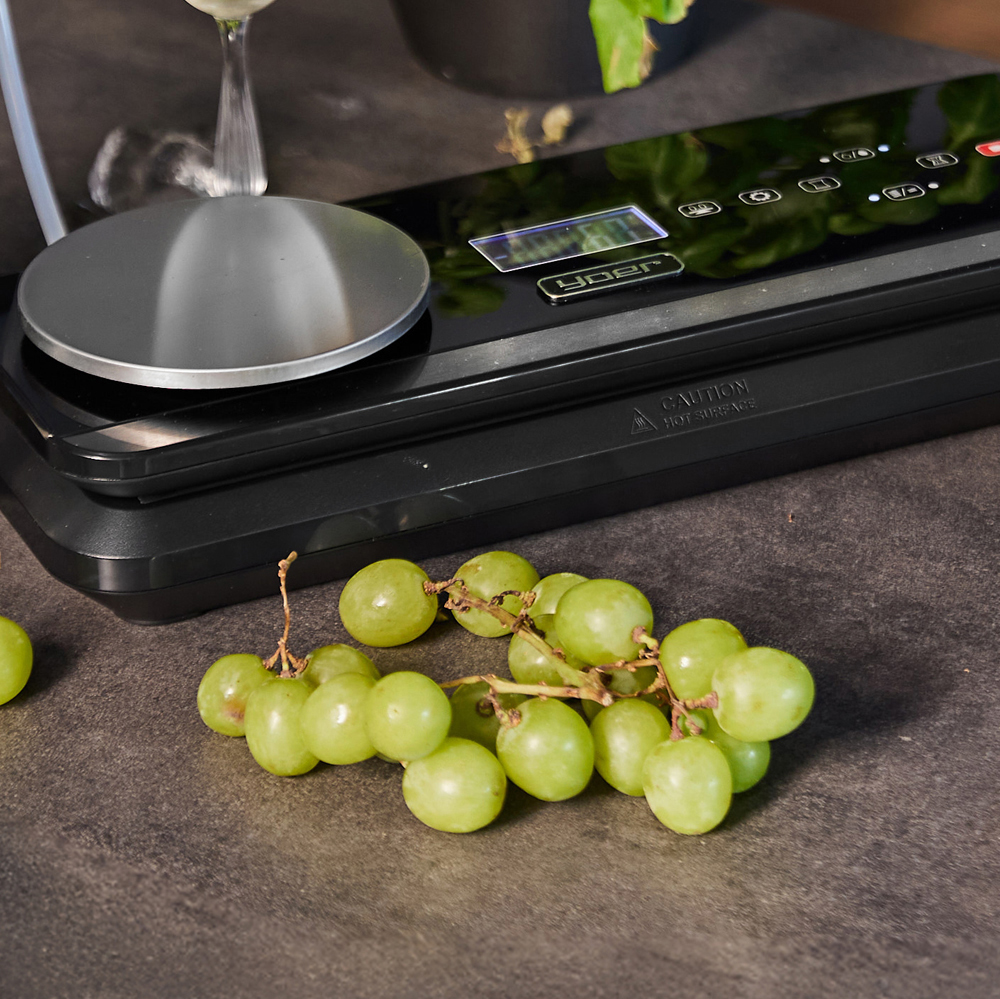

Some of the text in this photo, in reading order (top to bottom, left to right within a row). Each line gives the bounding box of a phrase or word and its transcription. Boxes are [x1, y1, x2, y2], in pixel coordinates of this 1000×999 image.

[661, 378, 750, 411] CAUTION
[663, 398, 758, 429] HOT SURFACE
